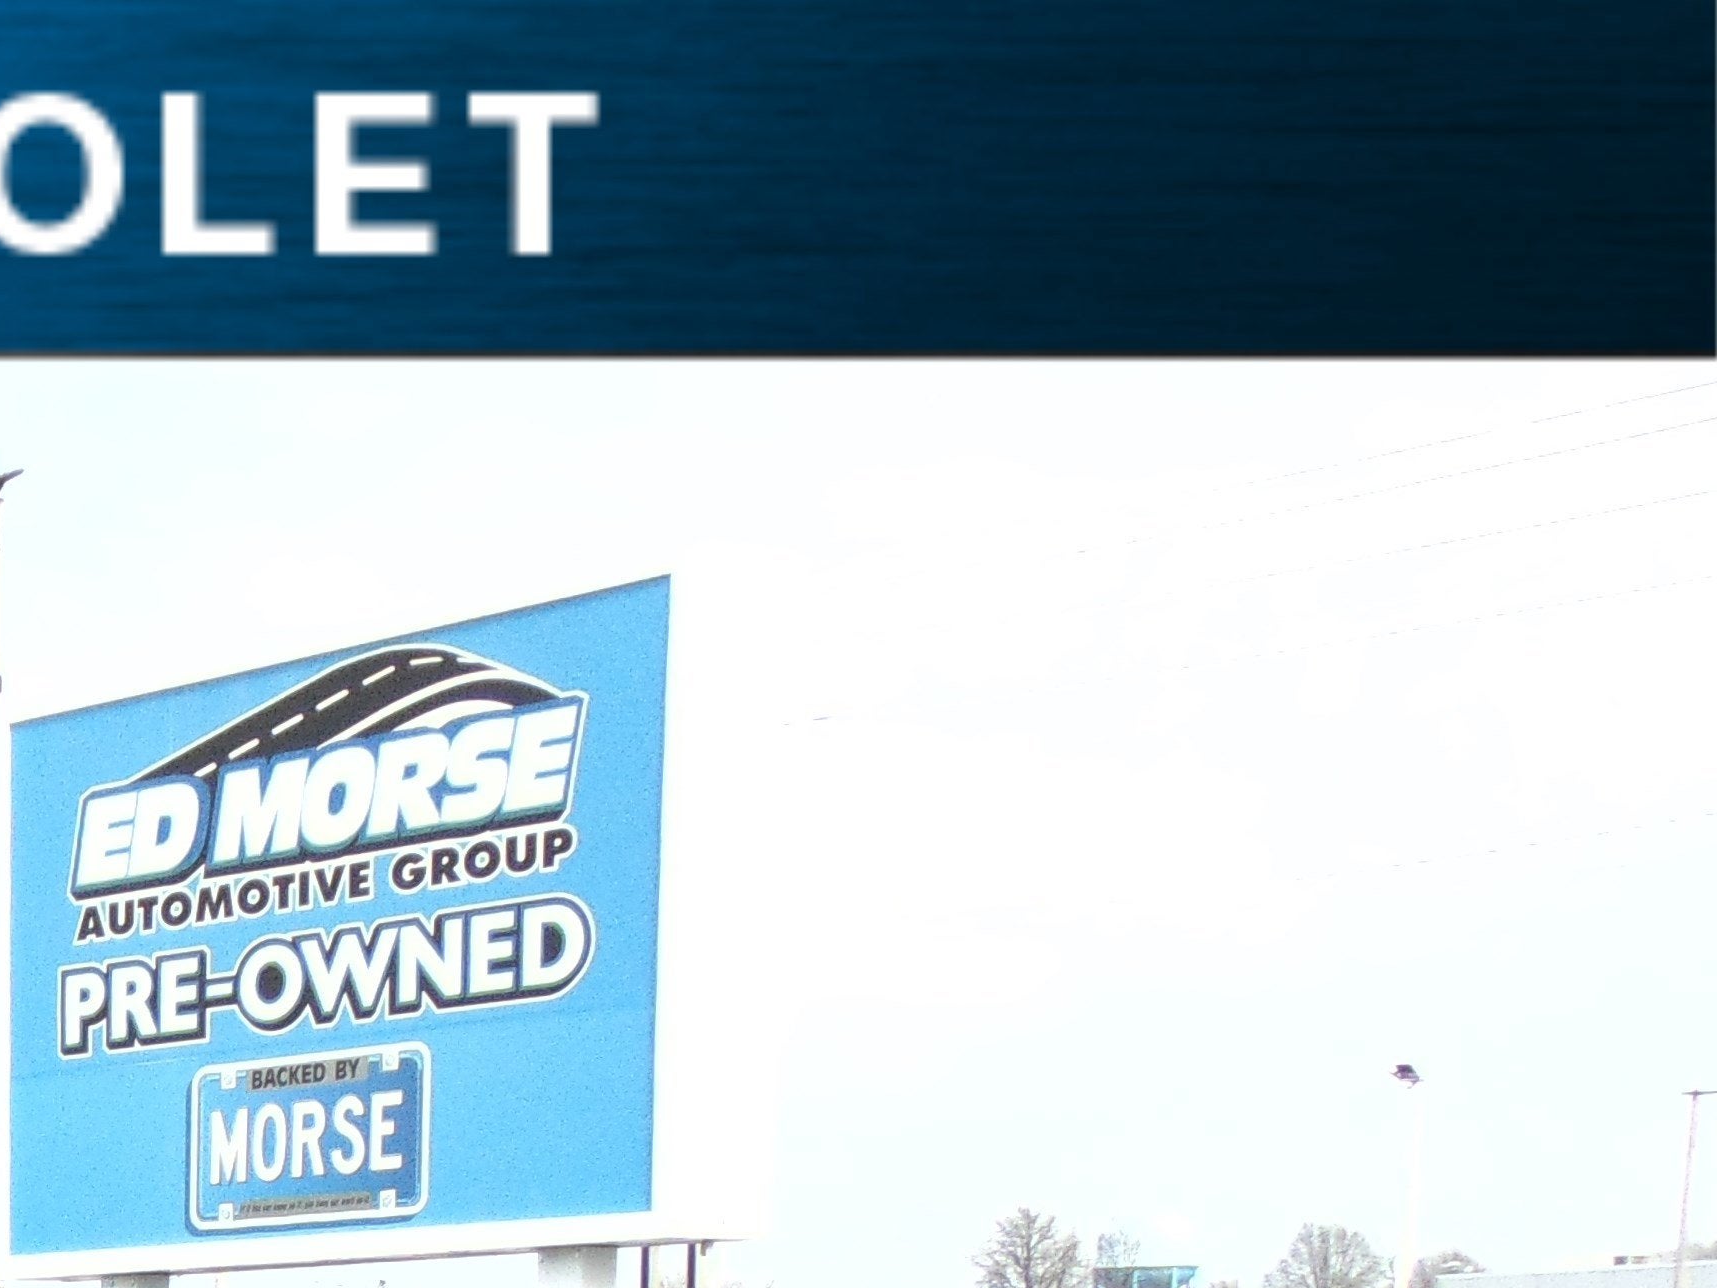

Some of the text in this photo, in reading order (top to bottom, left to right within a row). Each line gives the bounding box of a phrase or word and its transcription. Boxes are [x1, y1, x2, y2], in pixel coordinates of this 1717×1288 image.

[73, 700, 582, 893] ED MORSE
[76, 827, 575, 942] AUTOMOTIVE GROUP
[62, 900, 589, 1052] PRE-OWNED
[250, 1057, 362, 1091] BACKED BY
[208, 1088, 404, 1187] MORSE
